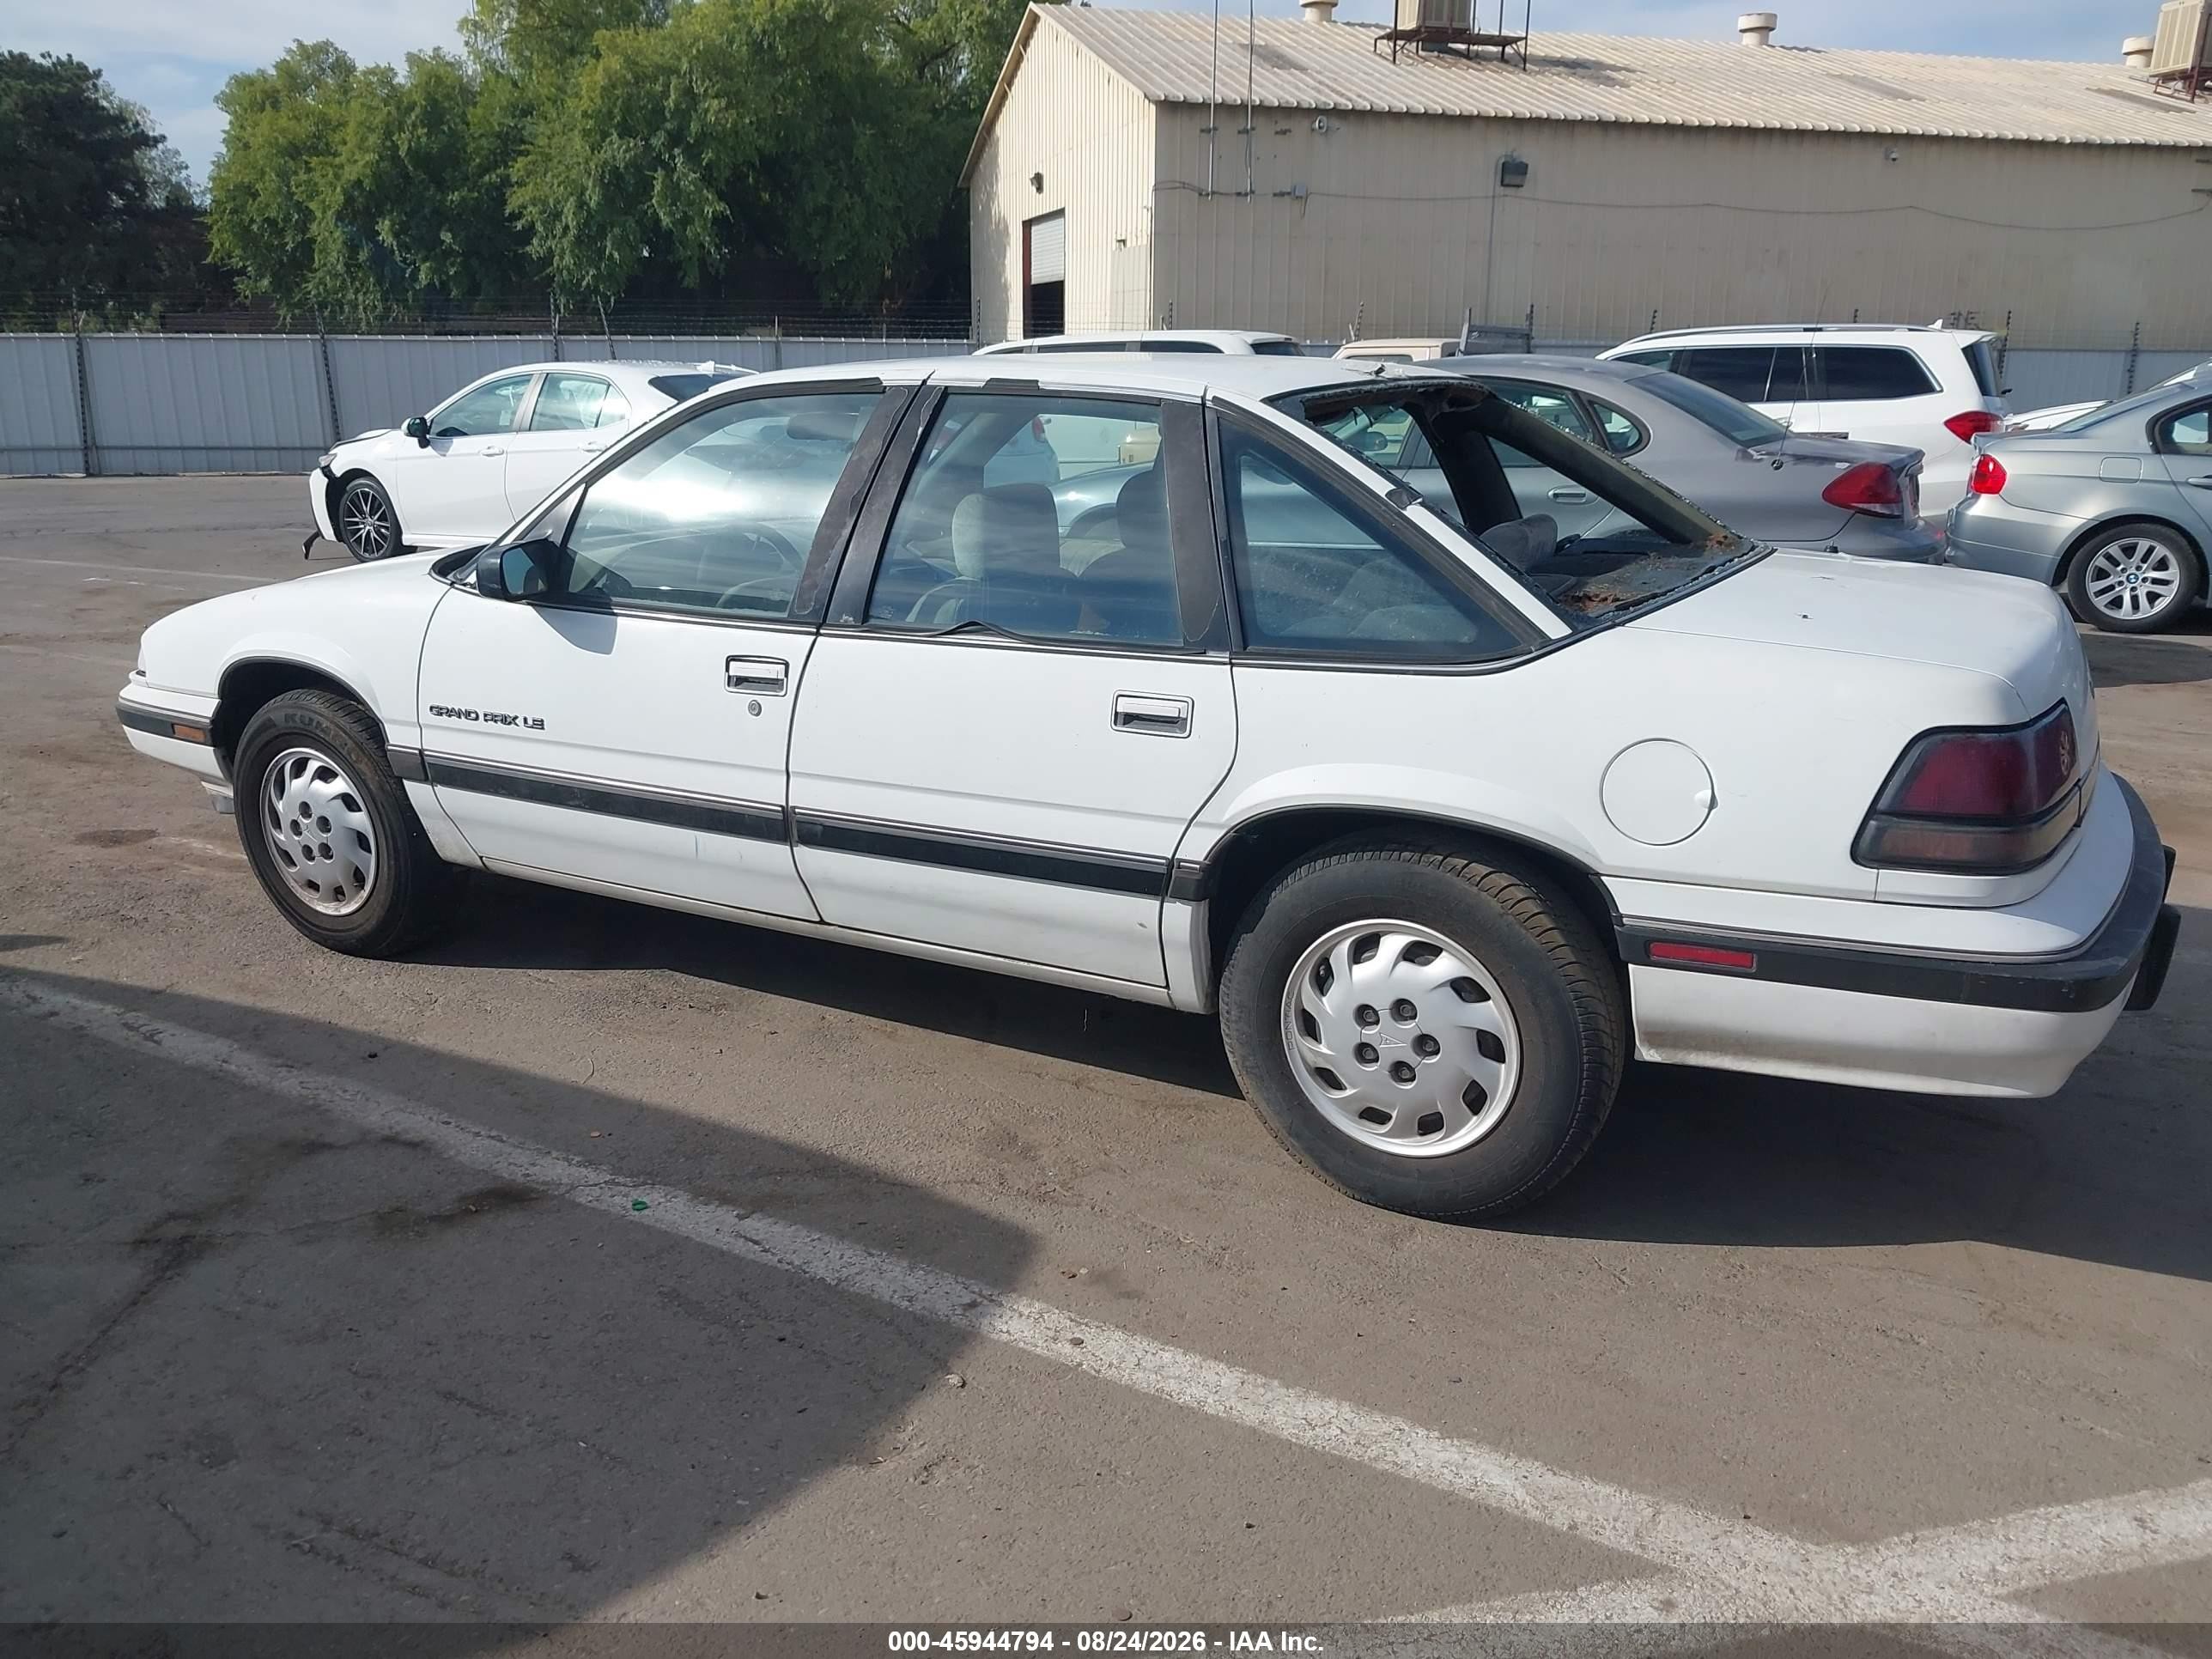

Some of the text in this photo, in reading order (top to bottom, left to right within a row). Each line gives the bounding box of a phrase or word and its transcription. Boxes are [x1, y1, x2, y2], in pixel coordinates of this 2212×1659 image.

[429, 704, 480, 721] GRAND
[483, 711, 520, 727] PRIX
[1284, 988, 1295, 1051] PONTIAC
